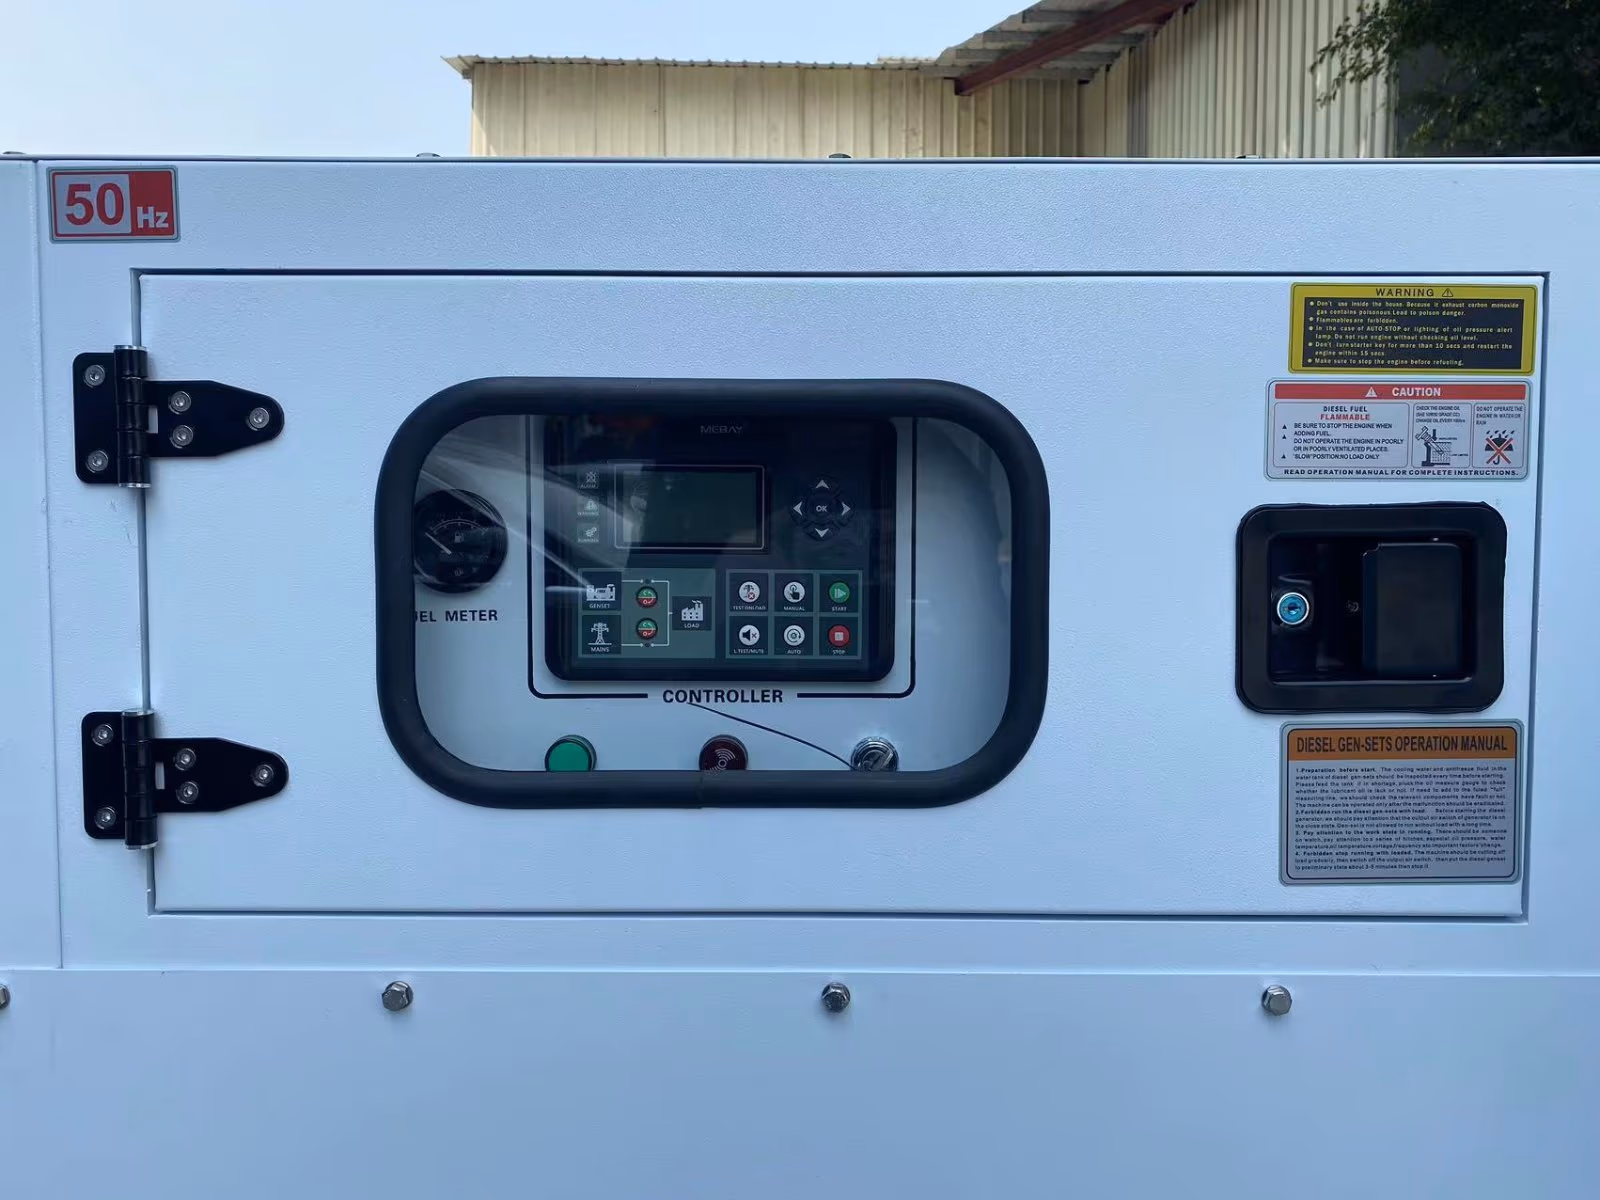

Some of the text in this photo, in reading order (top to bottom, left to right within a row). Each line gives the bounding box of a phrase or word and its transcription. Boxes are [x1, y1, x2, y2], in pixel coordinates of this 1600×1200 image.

[66, 182, 168, 228] 50 Hz
[1376, 288, 1434, 296] WARNING
[1392, 388, 1440, 396] CAUTION
[700, 425, 743, 434] MEBAY
[445, 610, 498, 621] METER
[663, 689, 783, 704] CONTROLLER
[1338, 736, 1392, 752] GEN-SETS
[1395, 736, 1458, 751] OPERATION
[1461, 736, 1507, 751] MANUAL
